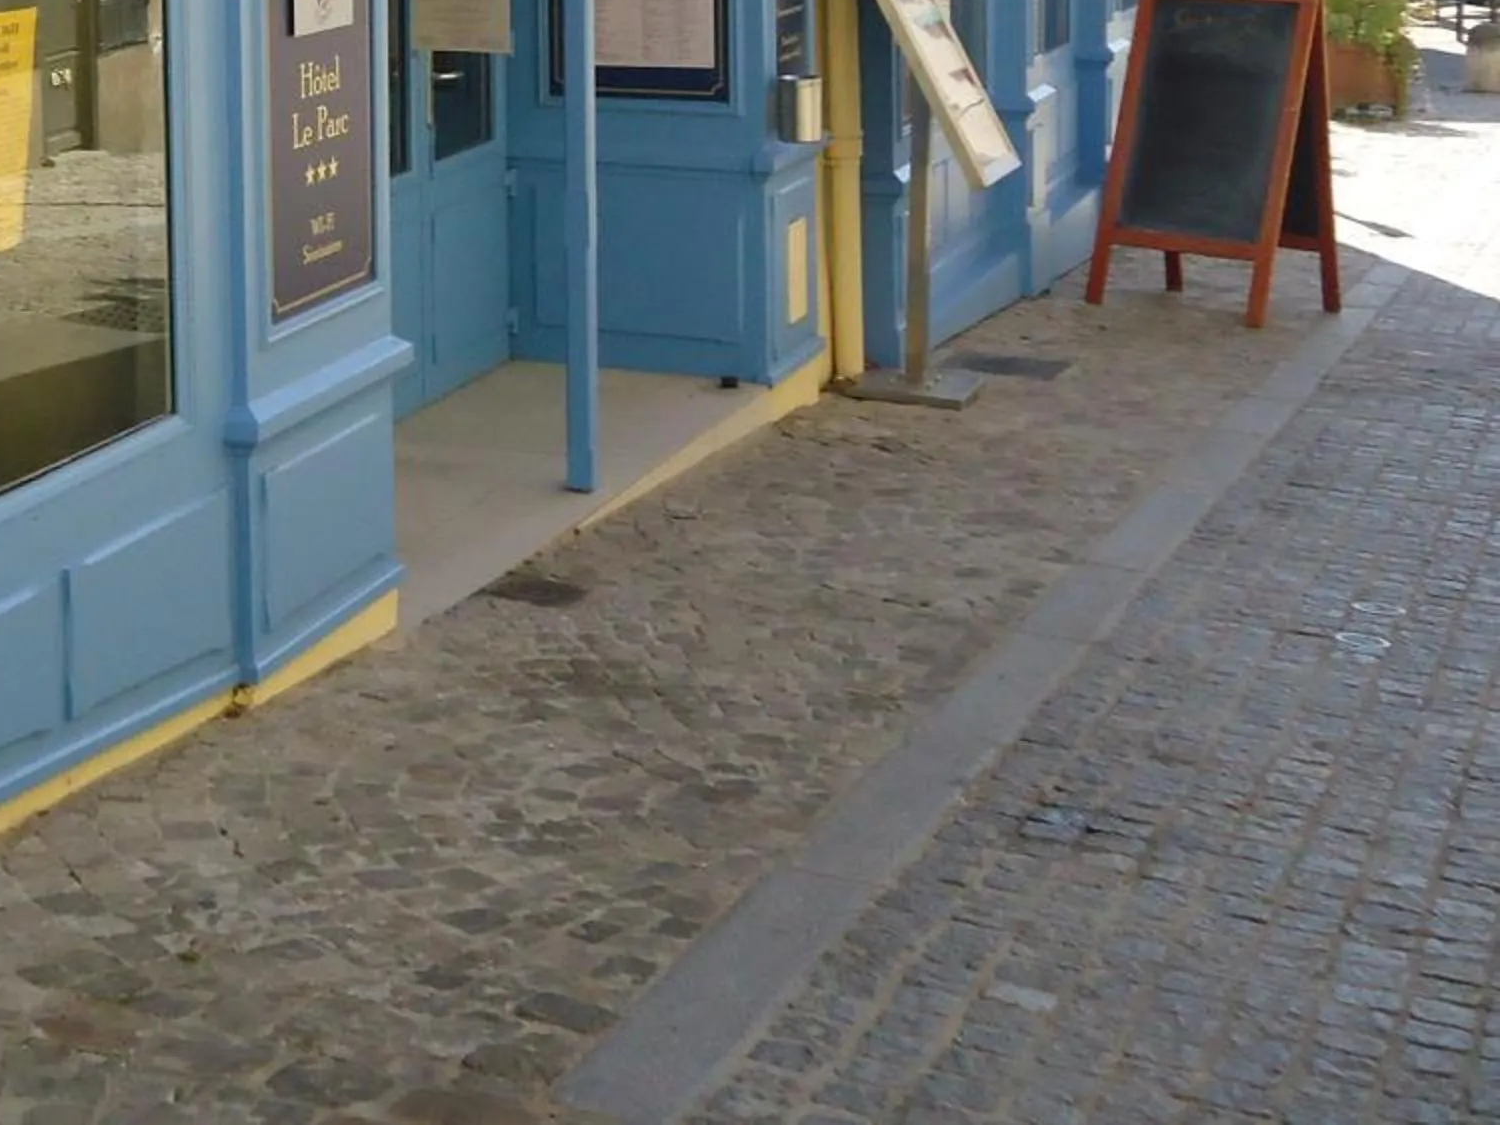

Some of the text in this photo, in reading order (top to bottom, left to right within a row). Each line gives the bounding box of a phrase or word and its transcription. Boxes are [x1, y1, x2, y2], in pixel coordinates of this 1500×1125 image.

[299, 53, 341, 100] Hôtel
[291, 104, 350, 150] Le Parc
